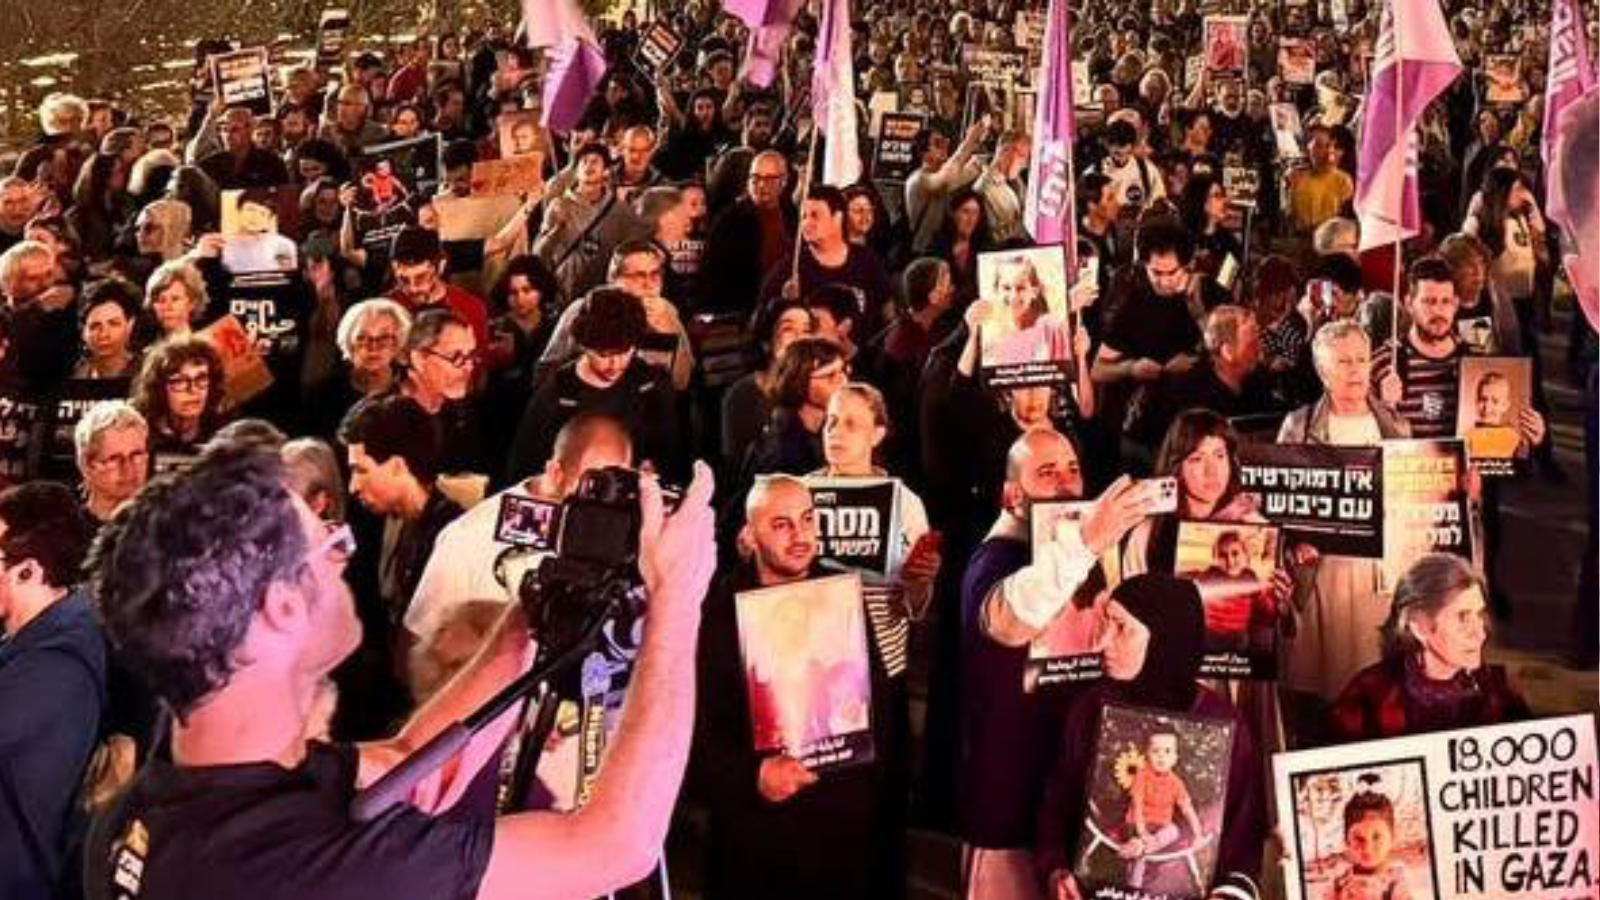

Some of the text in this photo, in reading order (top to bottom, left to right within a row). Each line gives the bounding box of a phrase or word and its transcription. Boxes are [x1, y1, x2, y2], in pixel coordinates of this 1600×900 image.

[1240, 467, 1340, 490] דמוקרטיה
[1345, 468, 1373, 493] אין
[1266, 493, 1373, 519] עם כיבוש
[1439, 765, 1594, 812] CHILDREN
[1453, 810, 1579, 852] KILLED
[1455, 855, 1485, 894] IN
